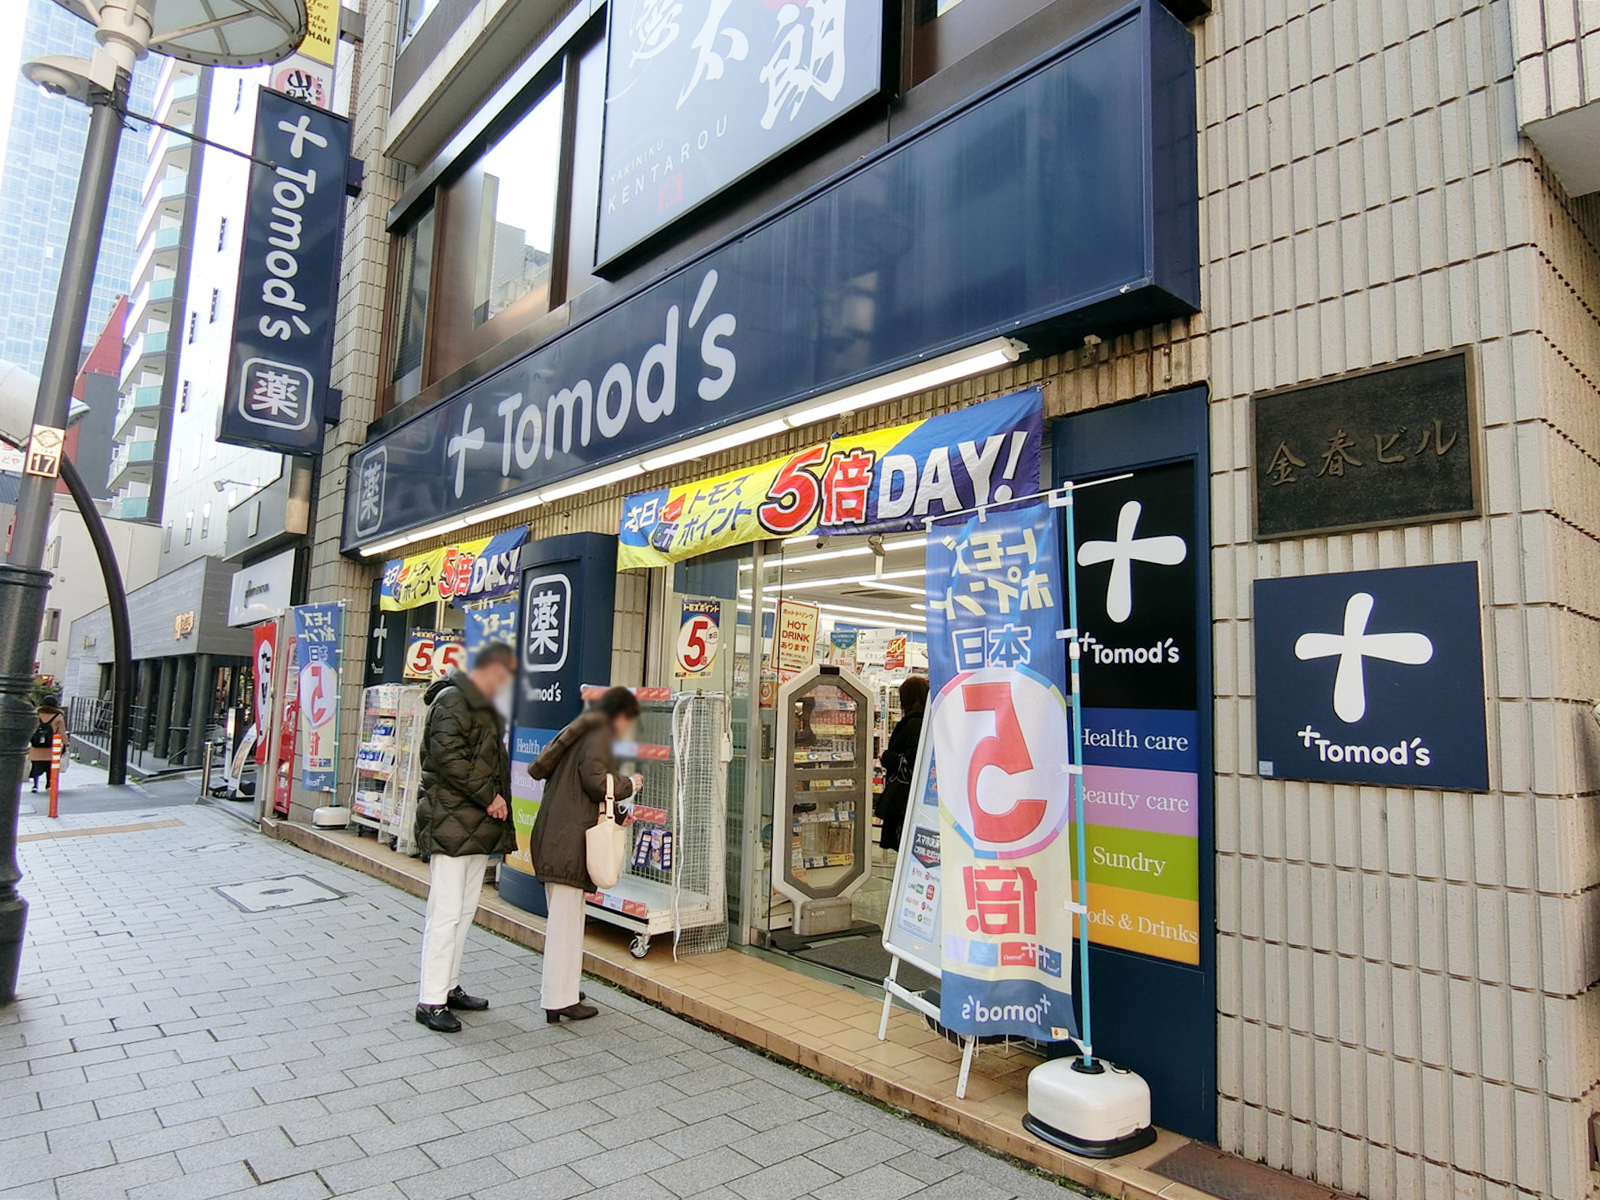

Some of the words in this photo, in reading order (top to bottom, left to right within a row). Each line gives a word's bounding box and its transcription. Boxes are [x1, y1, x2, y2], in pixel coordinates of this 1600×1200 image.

[608, 115, 728, 215] KENTAROU
[610, 138, 664, 184] YAKINIKU
[259, 169, 317, 341] Tomod's
[498, 269, 737, 477] Tomod's
[251, 370, 300, 419] 薬
[32, 454, 56, 473] 17
[1266, 418, 1459, 487] 金春ビル
[359, 461, 384, 521] 薬
[876, 431, 1029, 519] DAY!
[624, 498, 659, 533] 本日
[677, 500, 752, 546] ポイント
[529, 590, 561, 655] 薬
[782, 630, 810, 643] DRINK
[787, 620, 808, 631] HOT
[412, 643, 434, 671] 5
[440, 647, 459, 675] 5
[684, 620, 708, 668] 5
[781, 642, 809, 653] あります!
[1091, 637, 1180, 665] Tomod's
[516, 737, 541, 756] Health
[1144, 732, 1189, 751] care
[1314, 737, 1431, 767] Tomod's
[1146, 795, 1190, 813] care
[1092, 846, 1166, 876] Sundry
[1086, 909, 1114, 927] ods
[1118, 913, 1133, 931] &
[1138, 916, 1199, 945] Drinks
